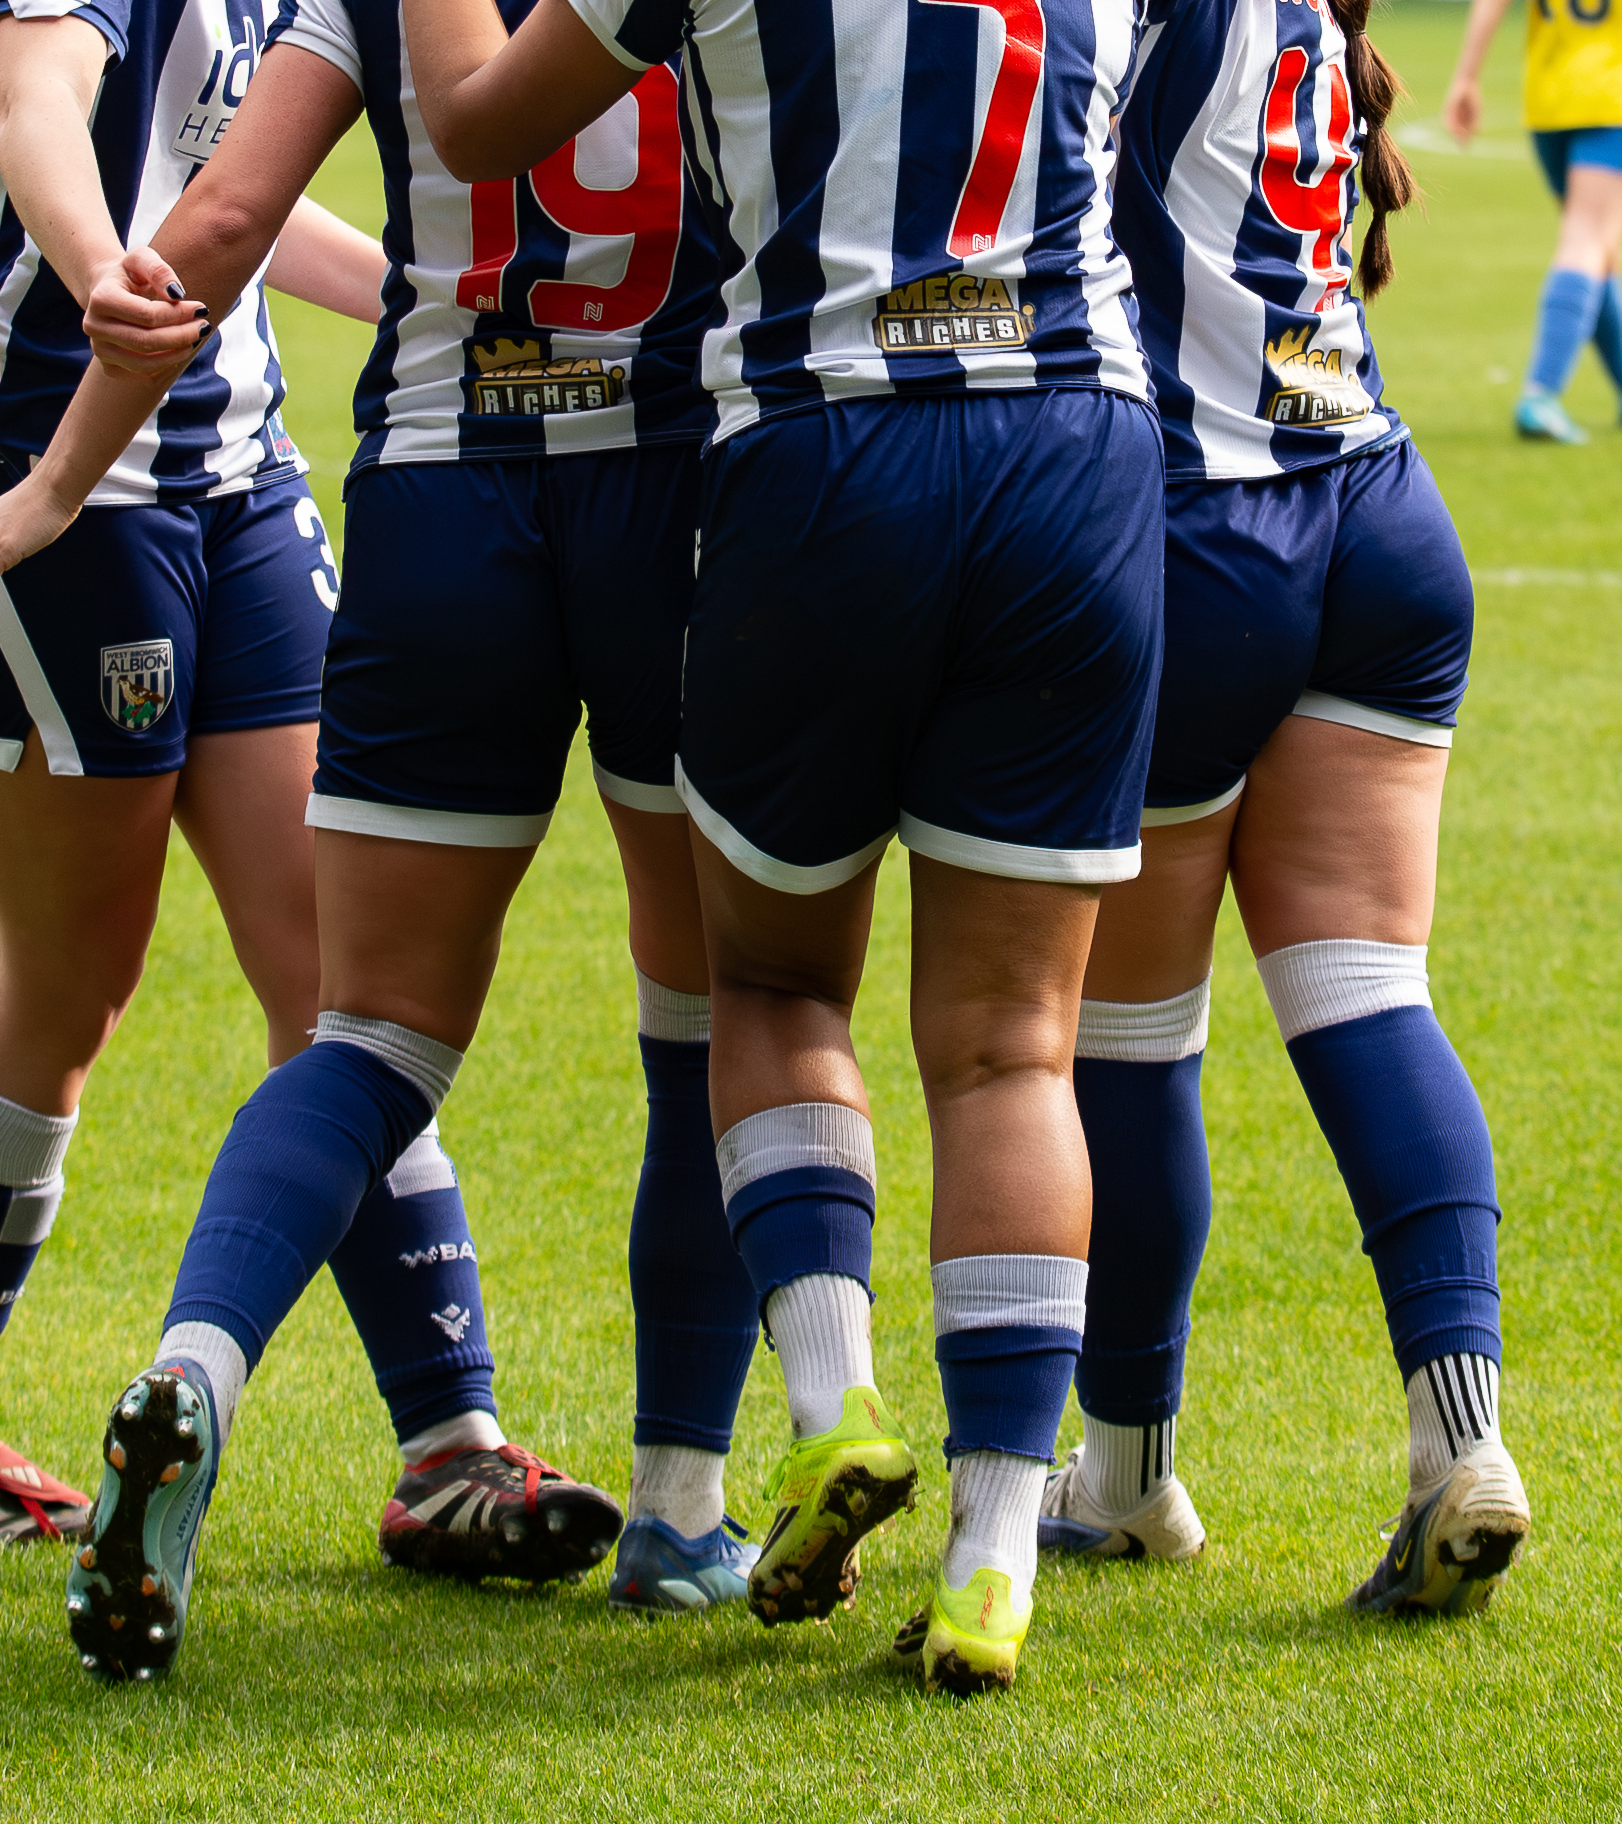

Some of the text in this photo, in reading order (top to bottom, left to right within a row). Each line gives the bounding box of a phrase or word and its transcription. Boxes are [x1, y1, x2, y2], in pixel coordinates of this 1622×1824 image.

[1259, 46, 1354, 313] 4
[886, 276, 1012, 310] MEGA
[886, 316, 1016, 345] RICHES
[482, 384, 603, 415] RICHES
[106, 651, 128, 659] WEST
[106, 653, 169, 674] ALBION
